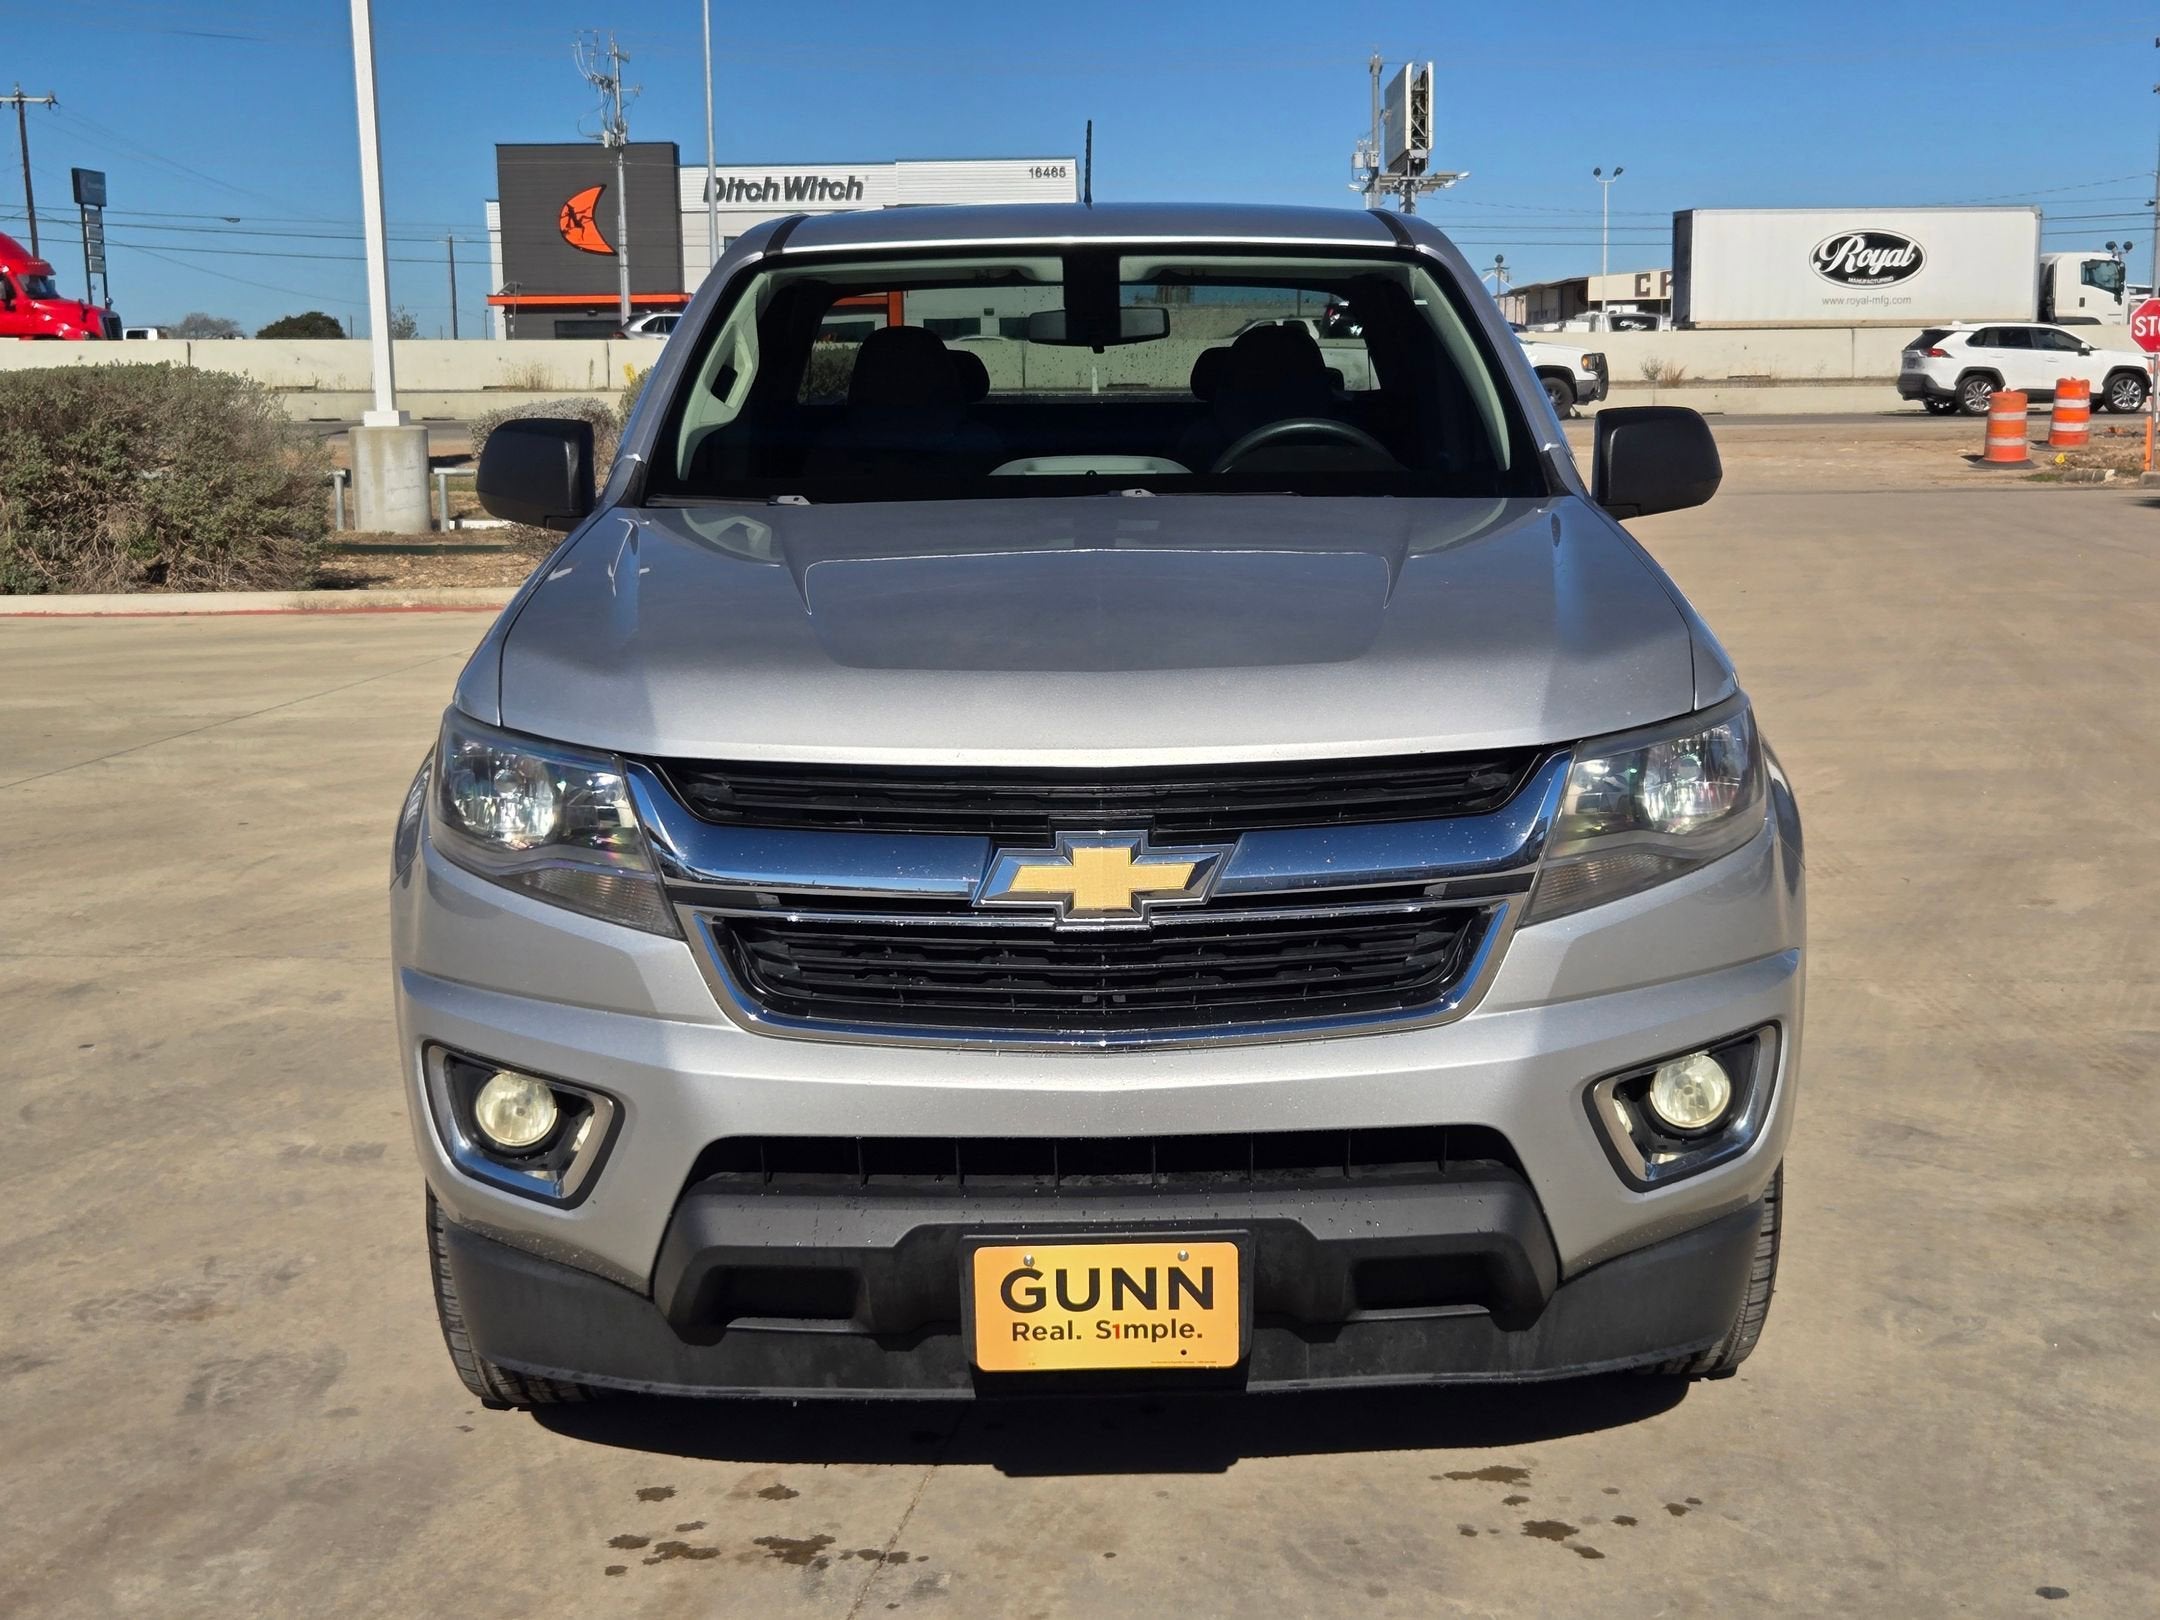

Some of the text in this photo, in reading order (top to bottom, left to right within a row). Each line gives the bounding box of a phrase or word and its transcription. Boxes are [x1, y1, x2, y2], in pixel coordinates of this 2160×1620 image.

[703, 176, 863, 203] Ditch Witch
[1813, 234, 1916, 275] Royal
[1822, 295, 1912, 307] www.royal-mfg.com
[1000, 1266, 1214, 1313] GUNN
[1012, 1320, 1082, 1342] Real.
